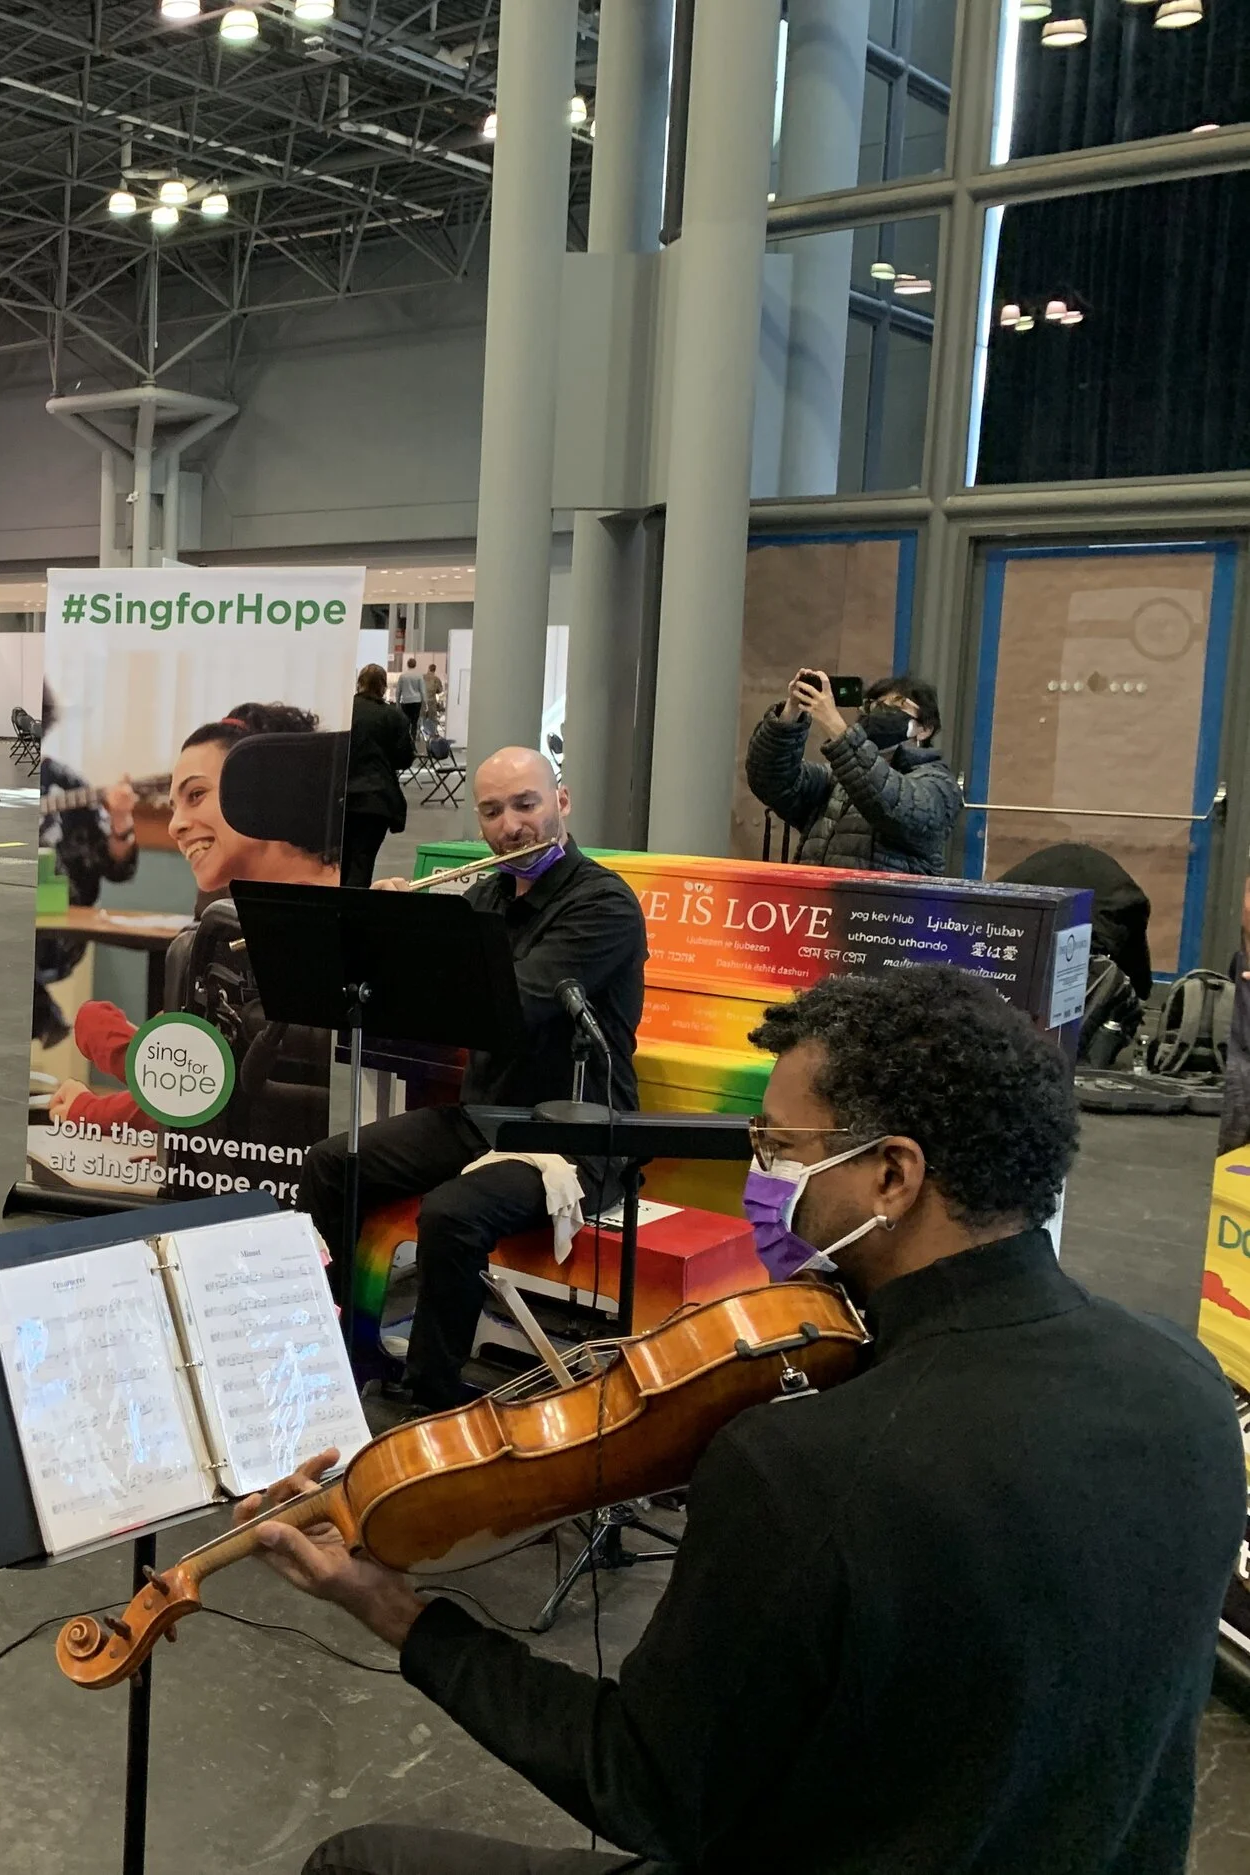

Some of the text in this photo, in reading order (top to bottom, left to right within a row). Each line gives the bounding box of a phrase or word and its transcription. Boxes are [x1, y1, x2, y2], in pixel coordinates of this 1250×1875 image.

[62, 592, 347, 631] #SingforHope
[678, 893, 714, 926] IS
[722, 898, 833, 939] LOVE
[850, 910, 914, 925] yog kev hlub
[927, 916, 1024, 938] Ljubav je ljubav
[734, 940, 770, 953] ljubezen
[848, 932, 948, 952] uthando uthando
[971, 941, 1019, 961] 愛は愛
[777, 965, 809, 977] dashuri
[147, 1041, 187, 1067] sing
[188, 1059, 208, 1075] for
[143, 1064, 216, 1096] hope
[46, 1114, 101, 1142] Join
[111, 1122, 156, 1148] the
[50, 1150, 76, 1172] at
